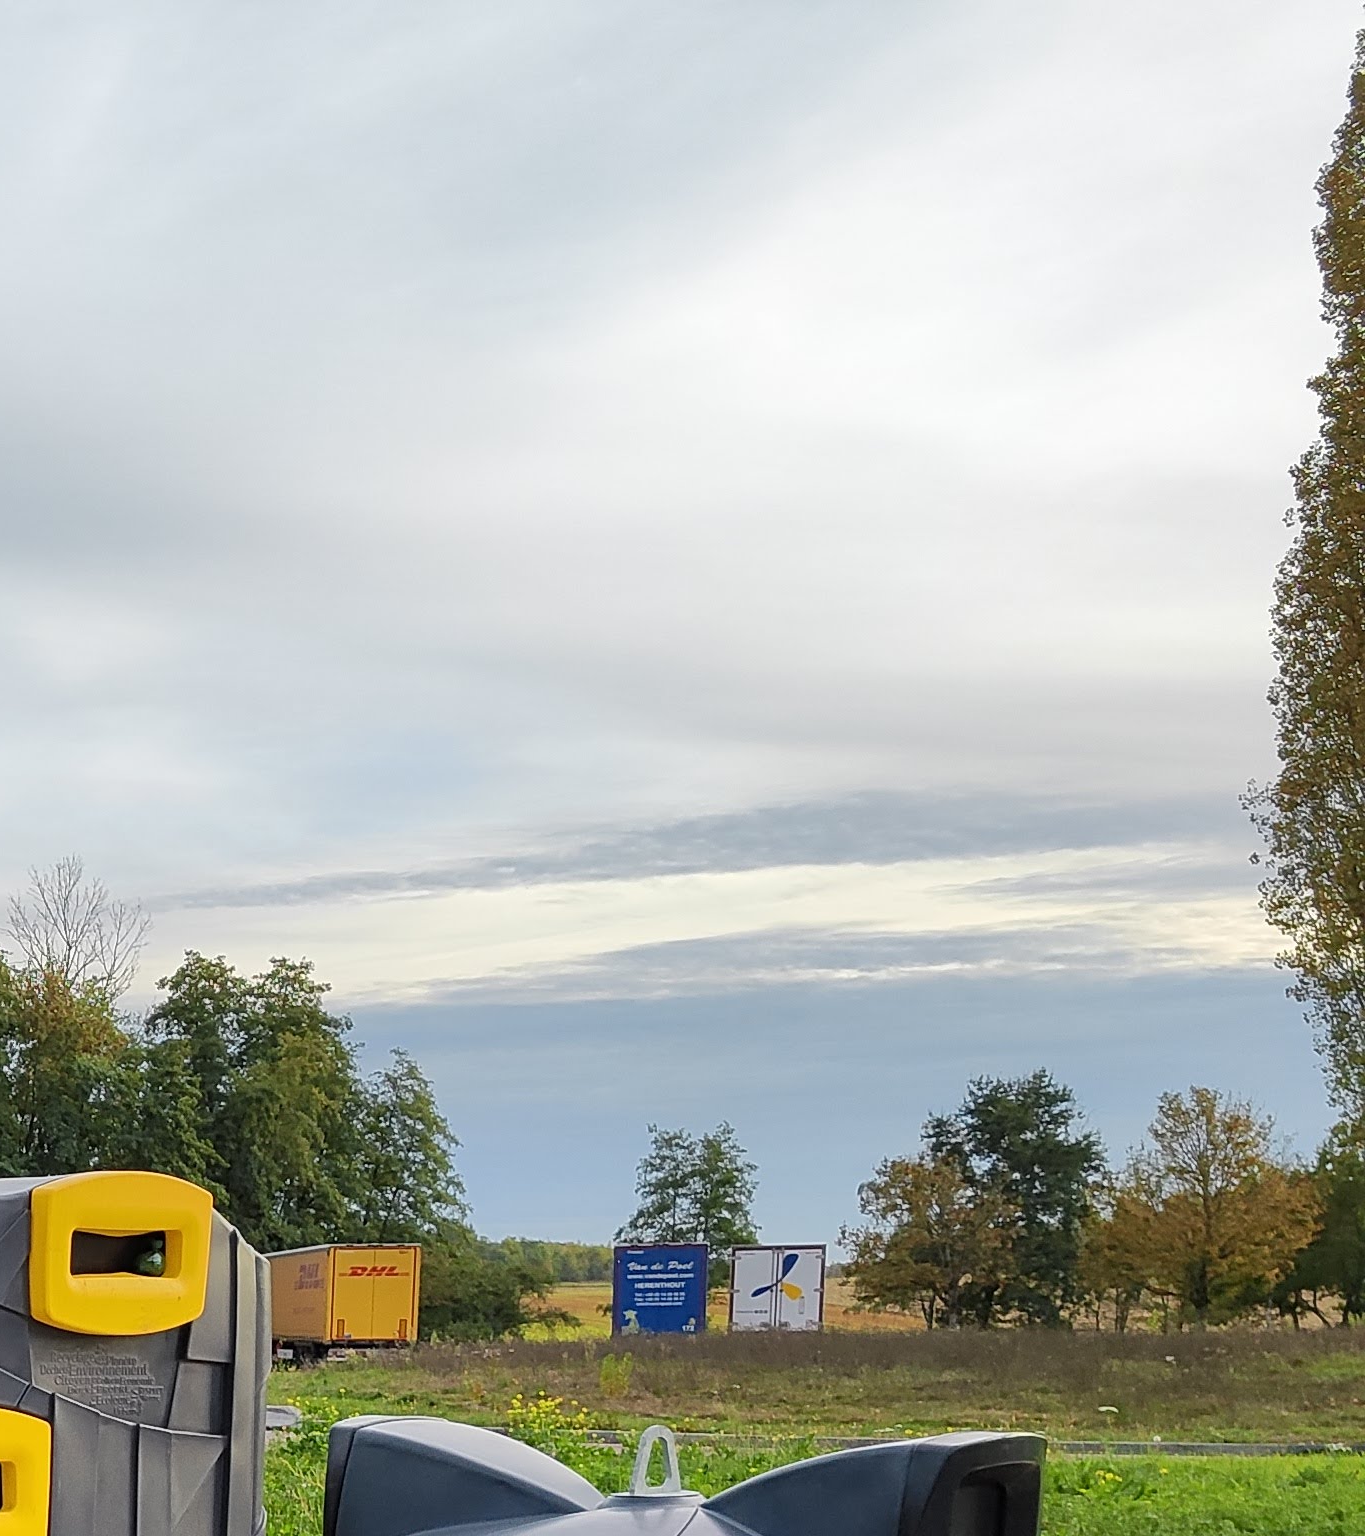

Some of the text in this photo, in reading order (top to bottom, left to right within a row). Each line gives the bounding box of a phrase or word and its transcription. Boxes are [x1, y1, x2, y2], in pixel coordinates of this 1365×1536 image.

[627, 1261, 694, 1271] Van de Poel
[348, 1266, 399, 1277] DHL
[634, 1281, 686, 1289] HERENTHOUT
[69, 1364, 148, 1376] Environnement
